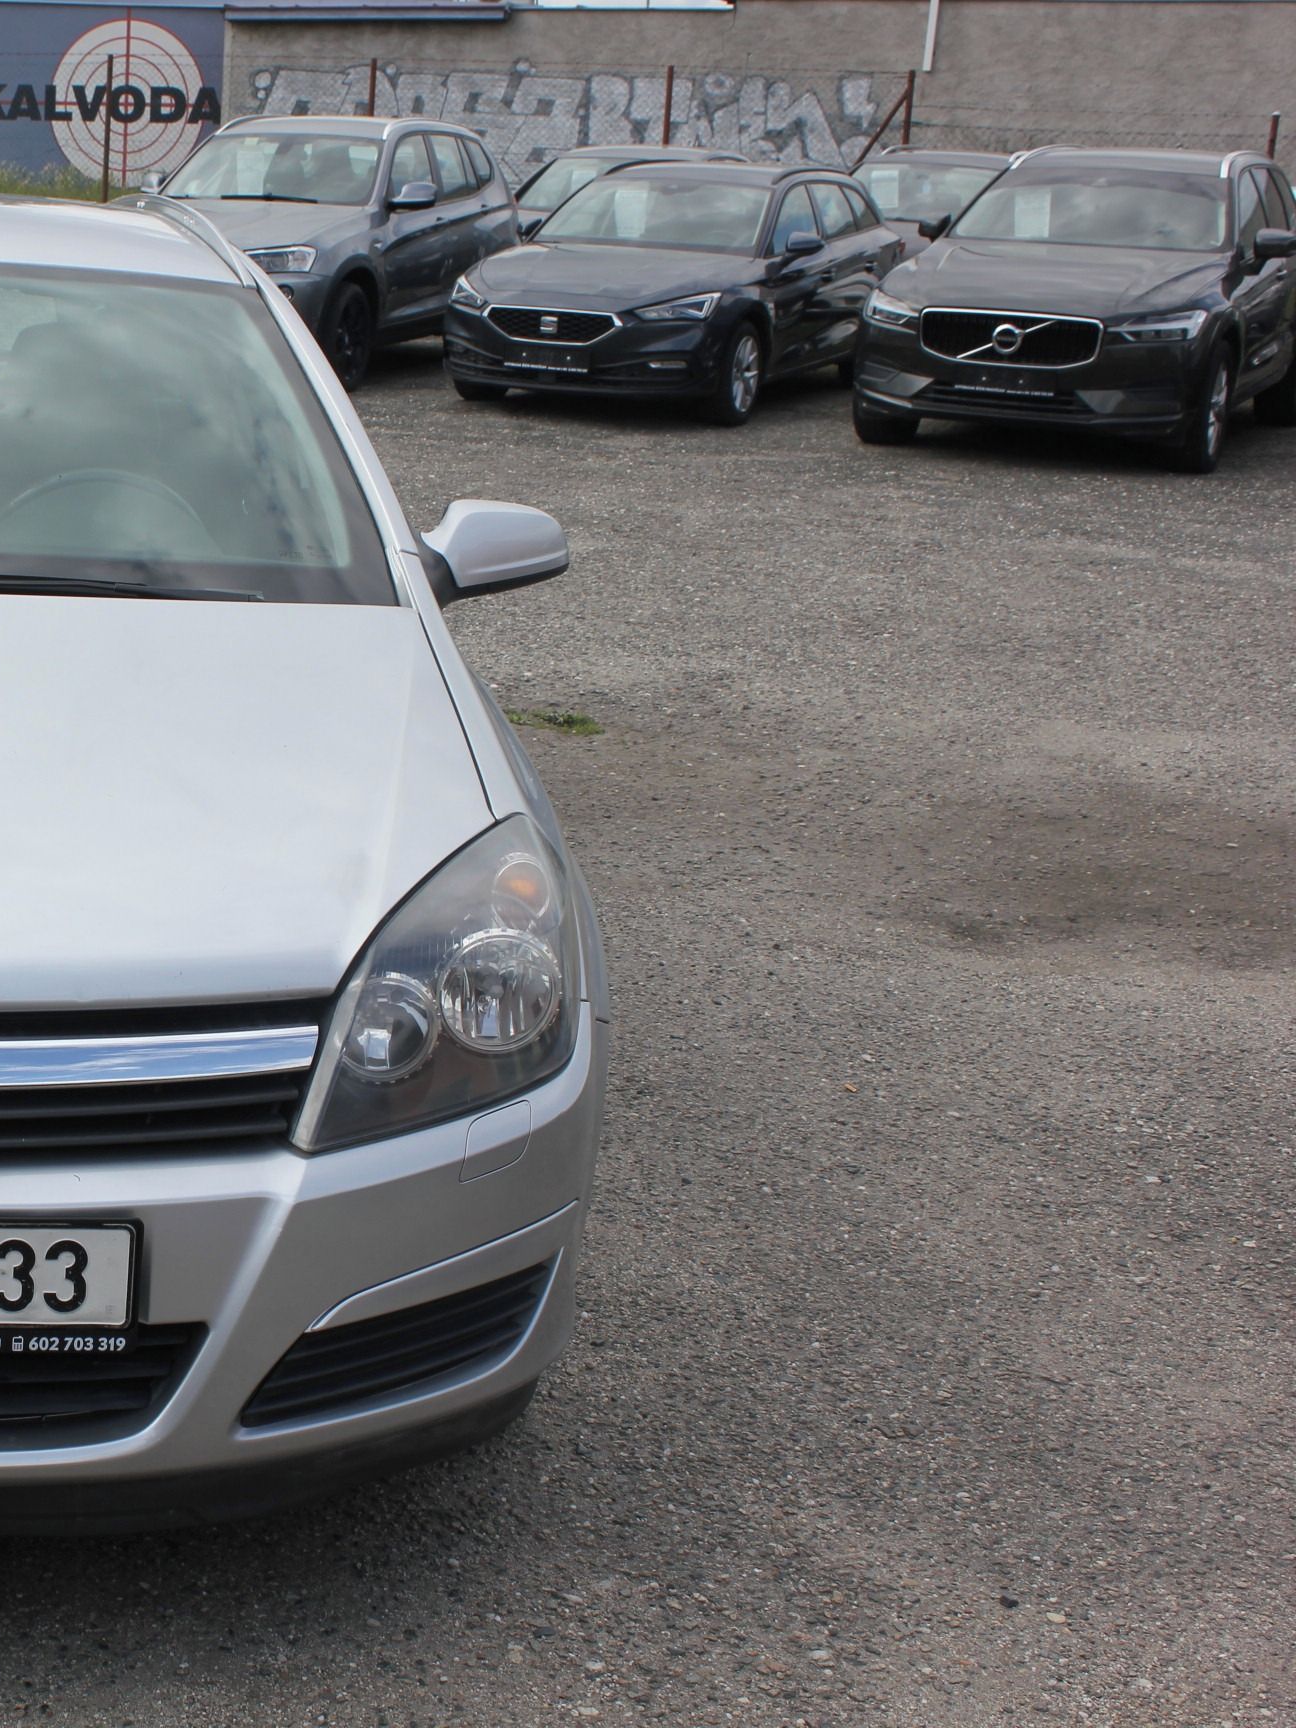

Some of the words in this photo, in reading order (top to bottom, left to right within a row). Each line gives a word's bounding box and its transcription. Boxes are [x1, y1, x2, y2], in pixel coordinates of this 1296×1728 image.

[29, 1337, 60, 1351] 602
[63, 1337, 95, 1351] 703
[98, 1338, 127, 1352] 319
